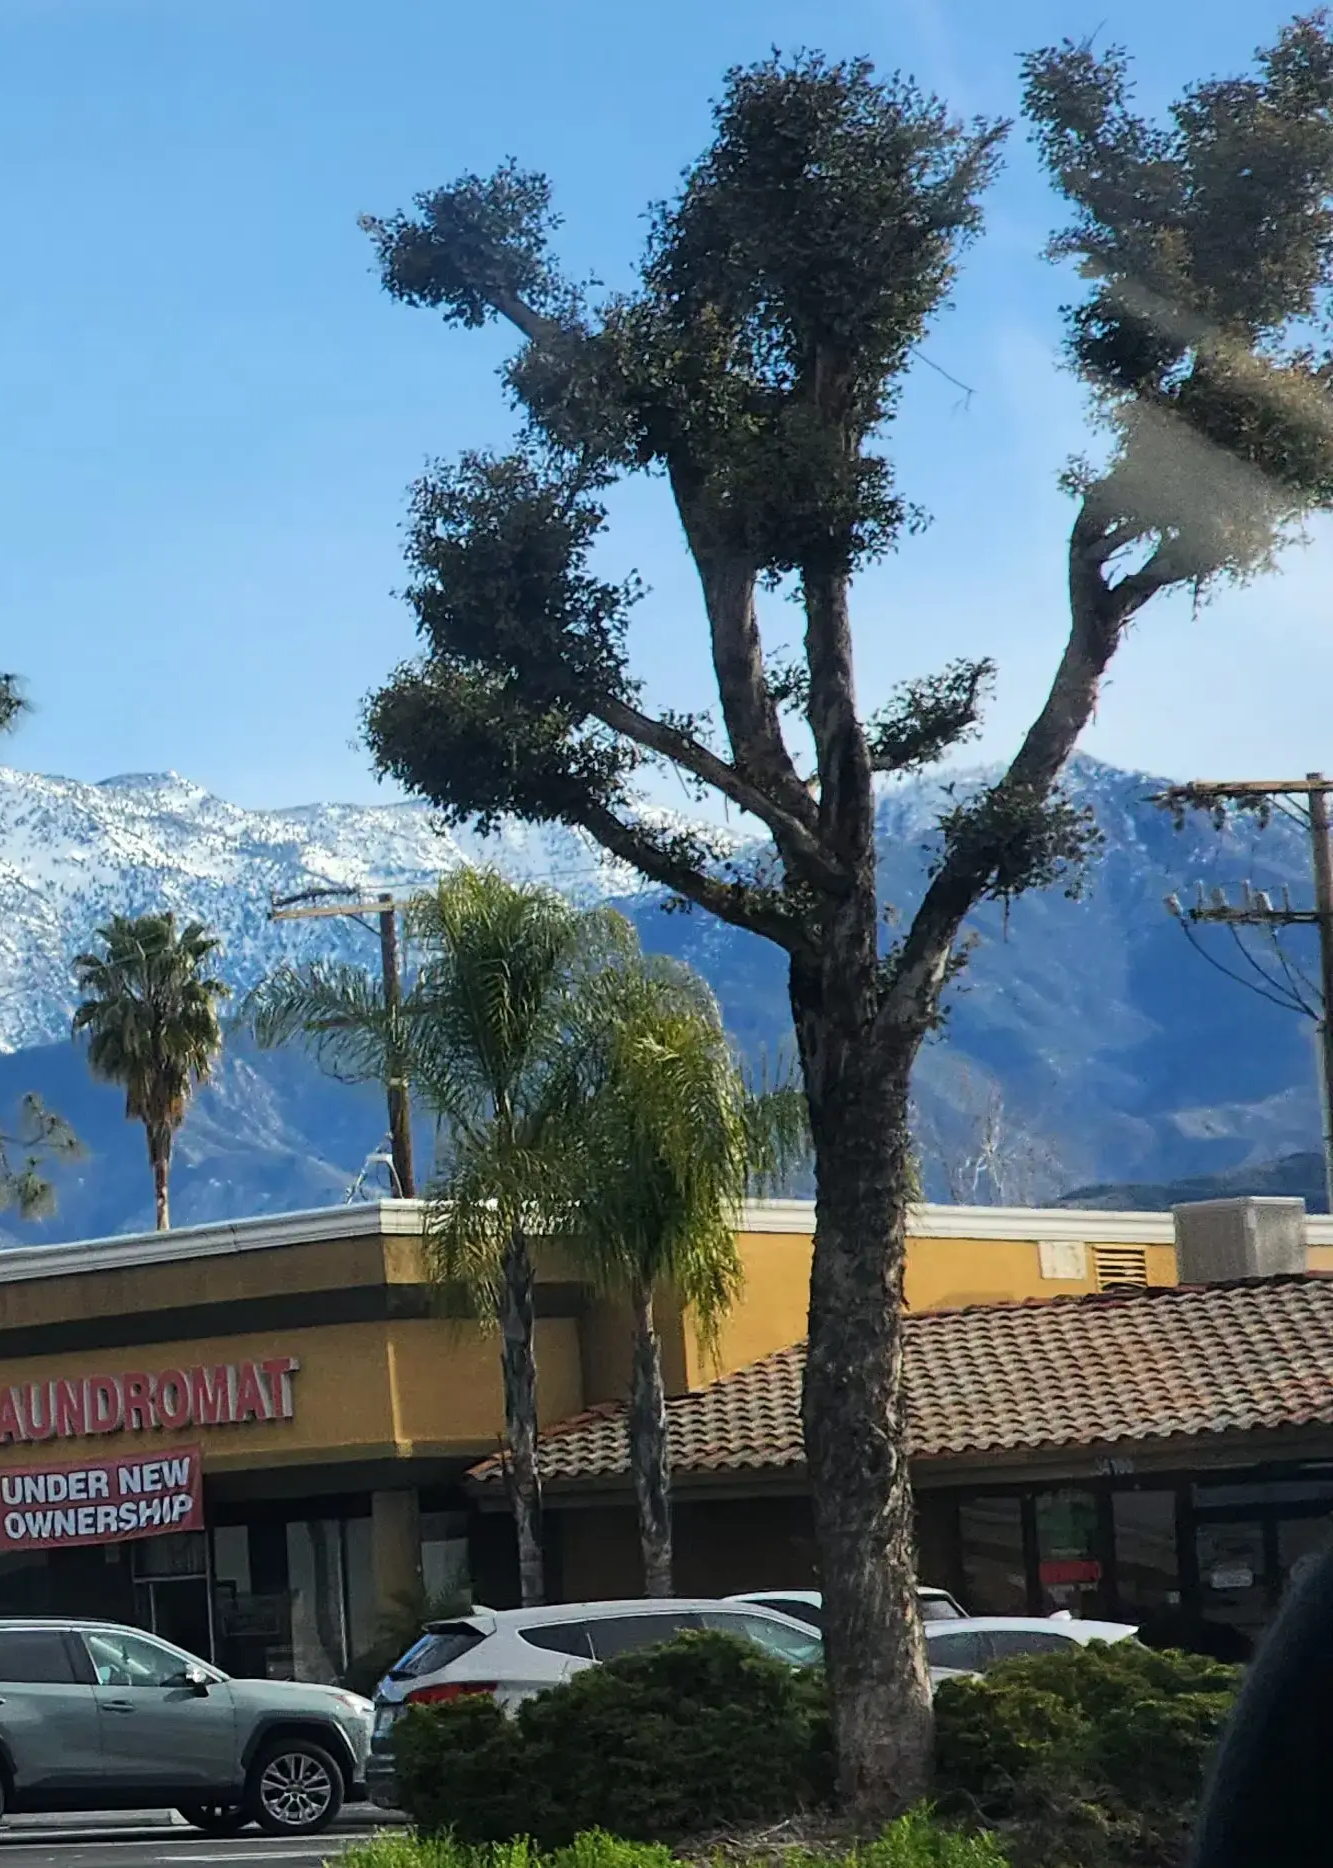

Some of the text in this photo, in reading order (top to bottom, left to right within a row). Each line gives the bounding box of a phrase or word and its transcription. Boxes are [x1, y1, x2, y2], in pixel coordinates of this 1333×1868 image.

[1, 1456, 191, 1506] UNDER NEW
[3, 1495, 193, 1541] OWNERSHIP
